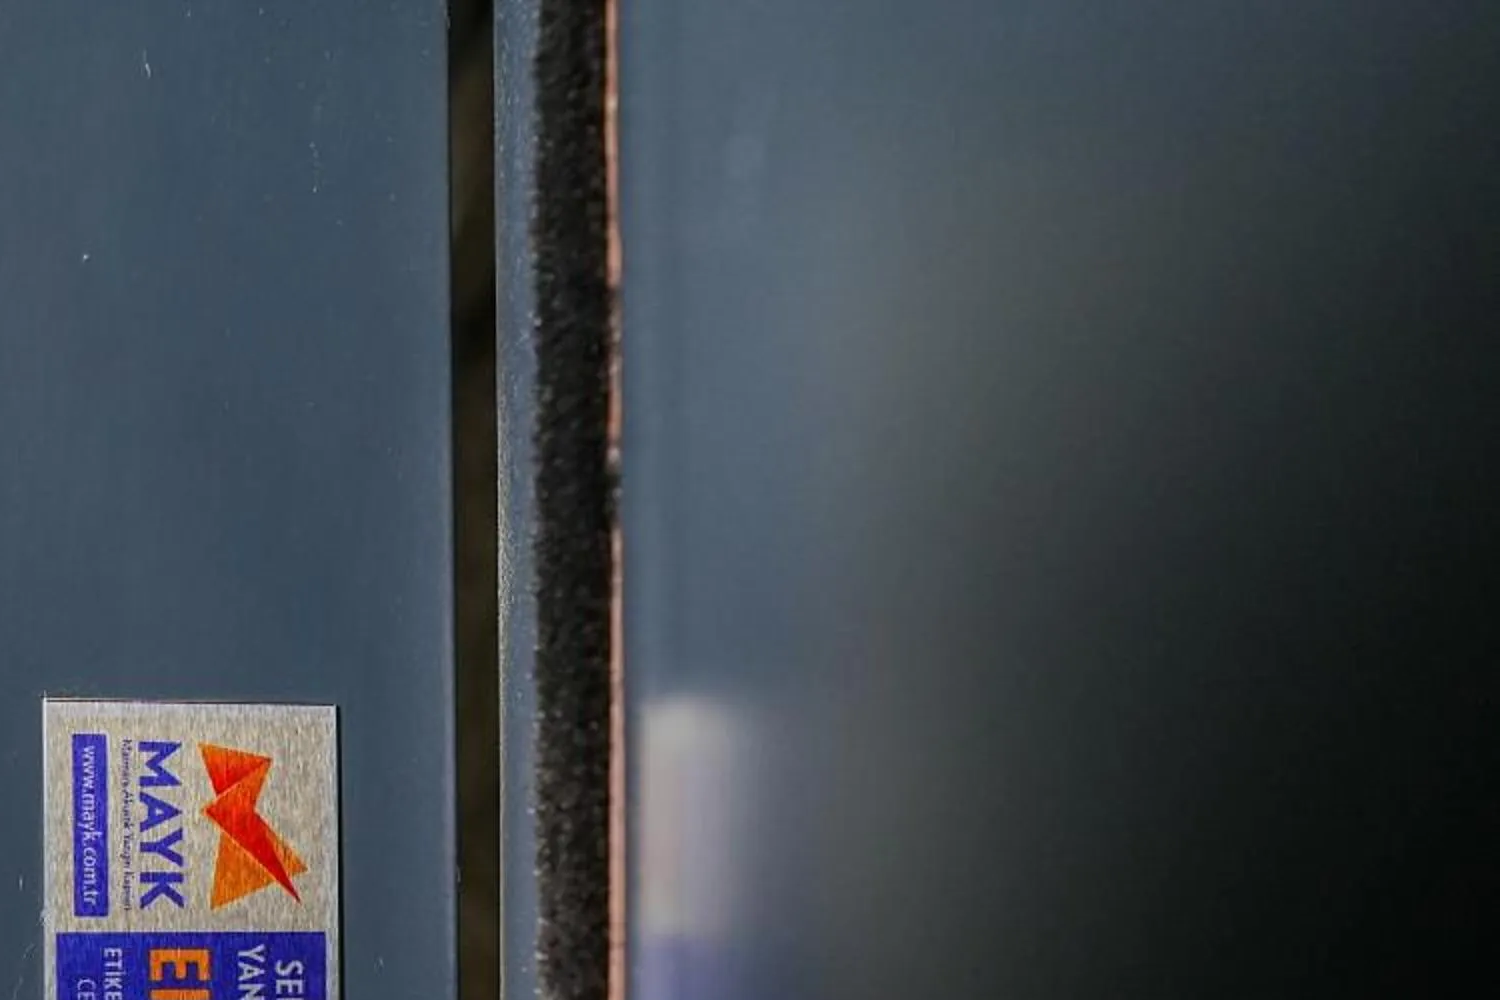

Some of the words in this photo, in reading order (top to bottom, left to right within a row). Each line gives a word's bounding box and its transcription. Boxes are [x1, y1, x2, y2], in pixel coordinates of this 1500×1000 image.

[79, 745, 102, 905] www.mayk.com.tr
[138, 741, 185, 910] MAYK
[77, 979, 95, 1000] CE
